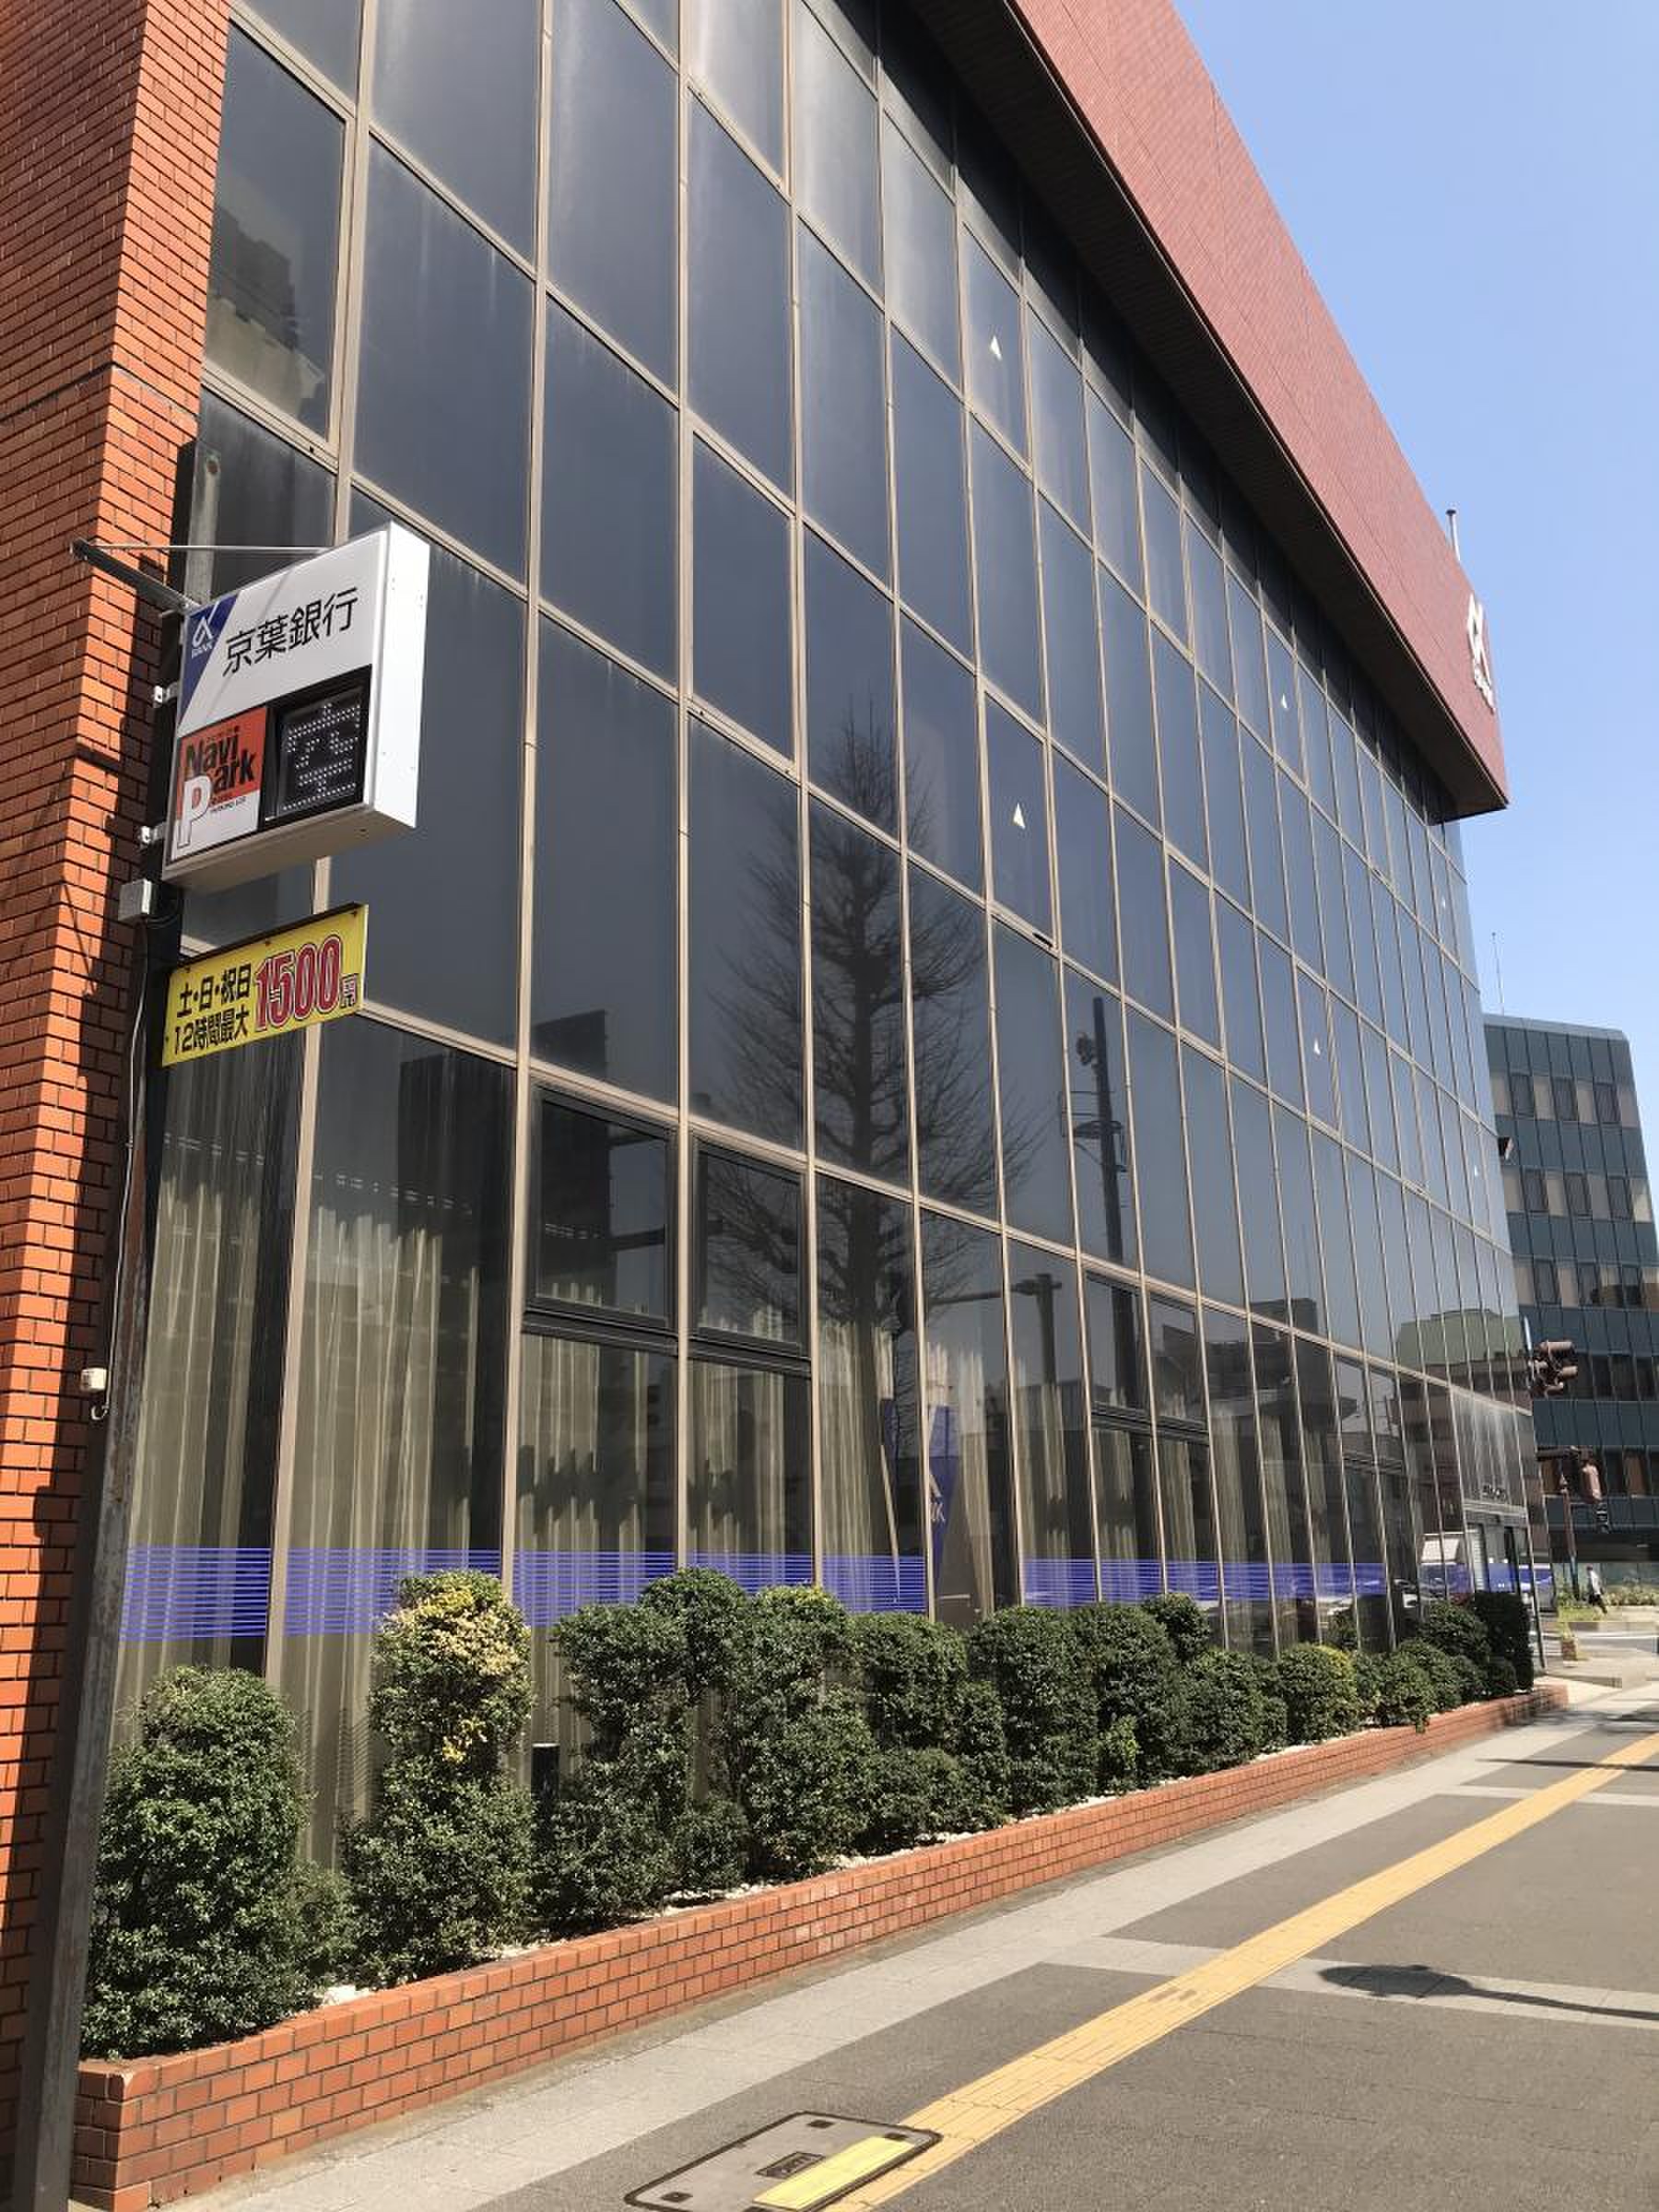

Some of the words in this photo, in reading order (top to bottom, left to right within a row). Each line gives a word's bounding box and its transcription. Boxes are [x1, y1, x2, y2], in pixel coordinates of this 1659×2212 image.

[223, 588, 359, 676] 京葉銀行
[184, 725, 239, 780] Navi
